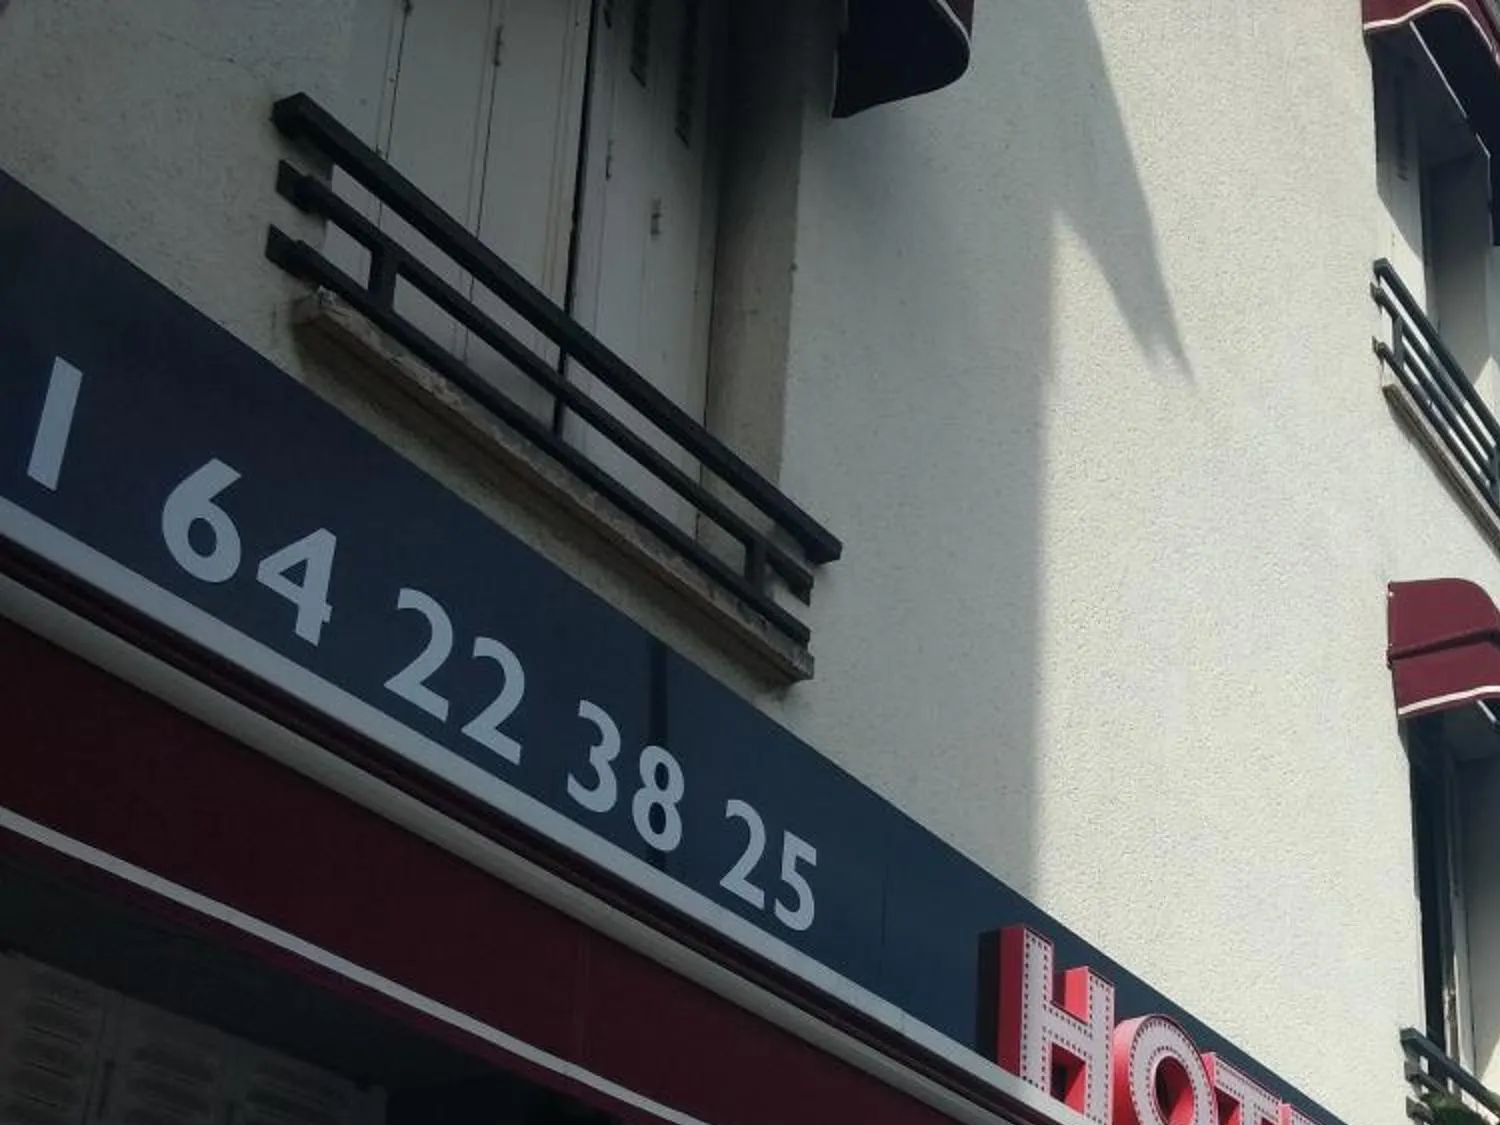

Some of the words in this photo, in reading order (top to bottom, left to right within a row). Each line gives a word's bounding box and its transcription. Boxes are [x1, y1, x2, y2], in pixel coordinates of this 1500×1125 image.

[161, 458, 338, 647] 64
[383, 588, 526, 766] 22
[567, 700, 685, 852] 38
[720, 799, 818, 931] 25
